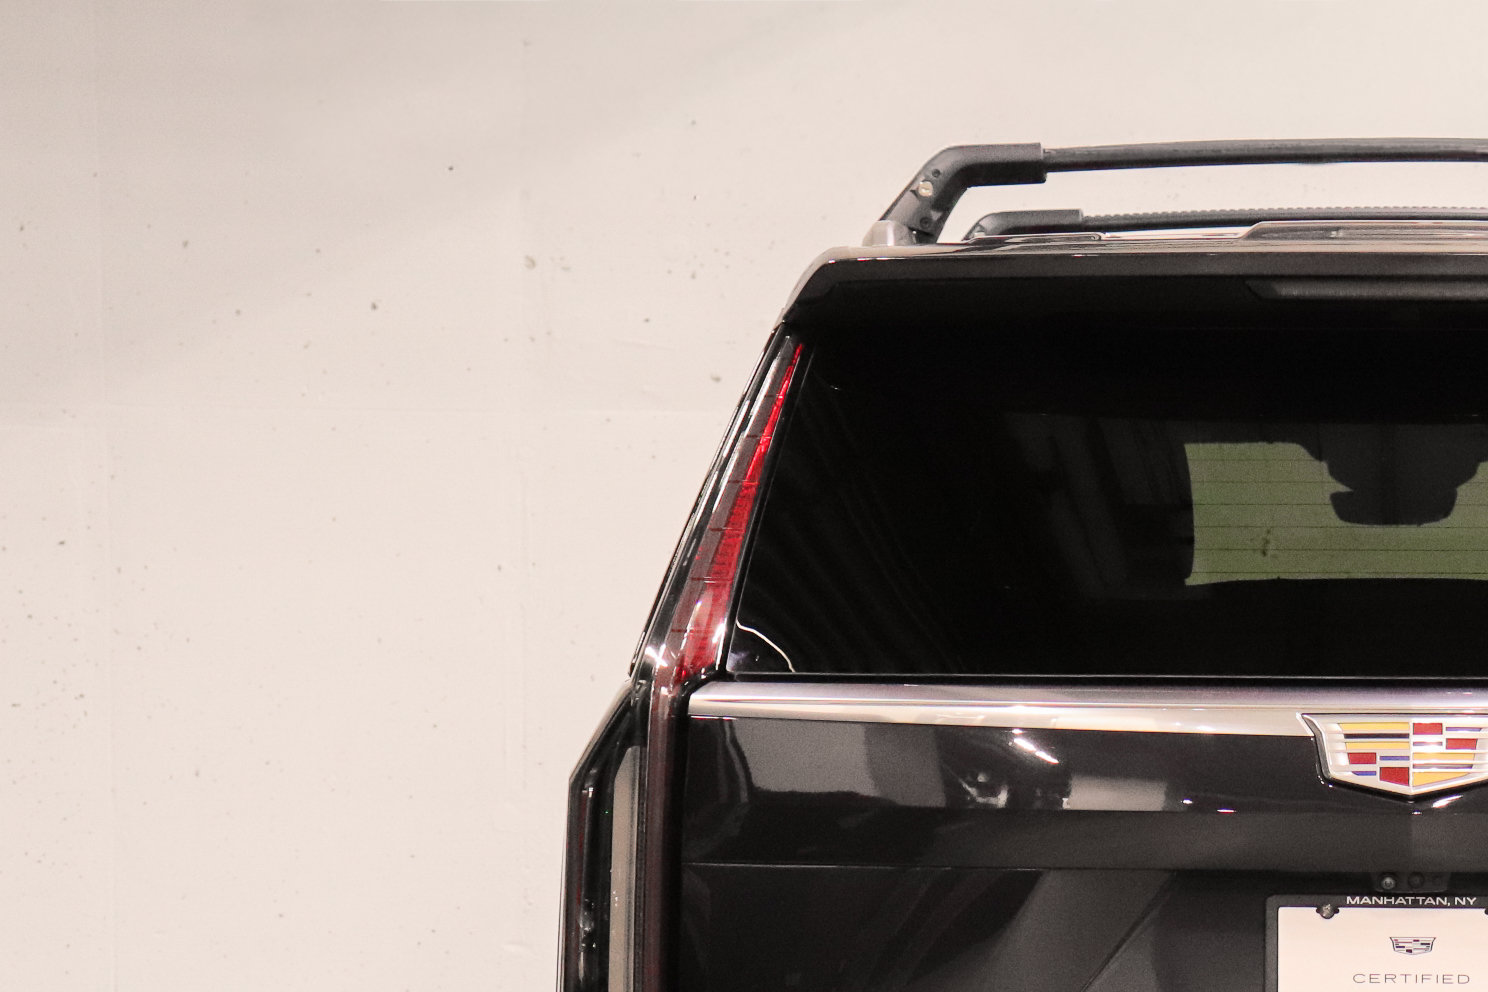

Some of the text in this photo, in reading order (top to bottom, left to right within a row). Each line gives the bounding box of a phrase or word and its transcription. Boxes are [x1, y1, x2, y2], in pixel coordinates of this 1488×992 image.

[1346, 896, 1477, 906] MANHATTAN, NY
[1352, 973, 1471, 985] CERTIFIED
